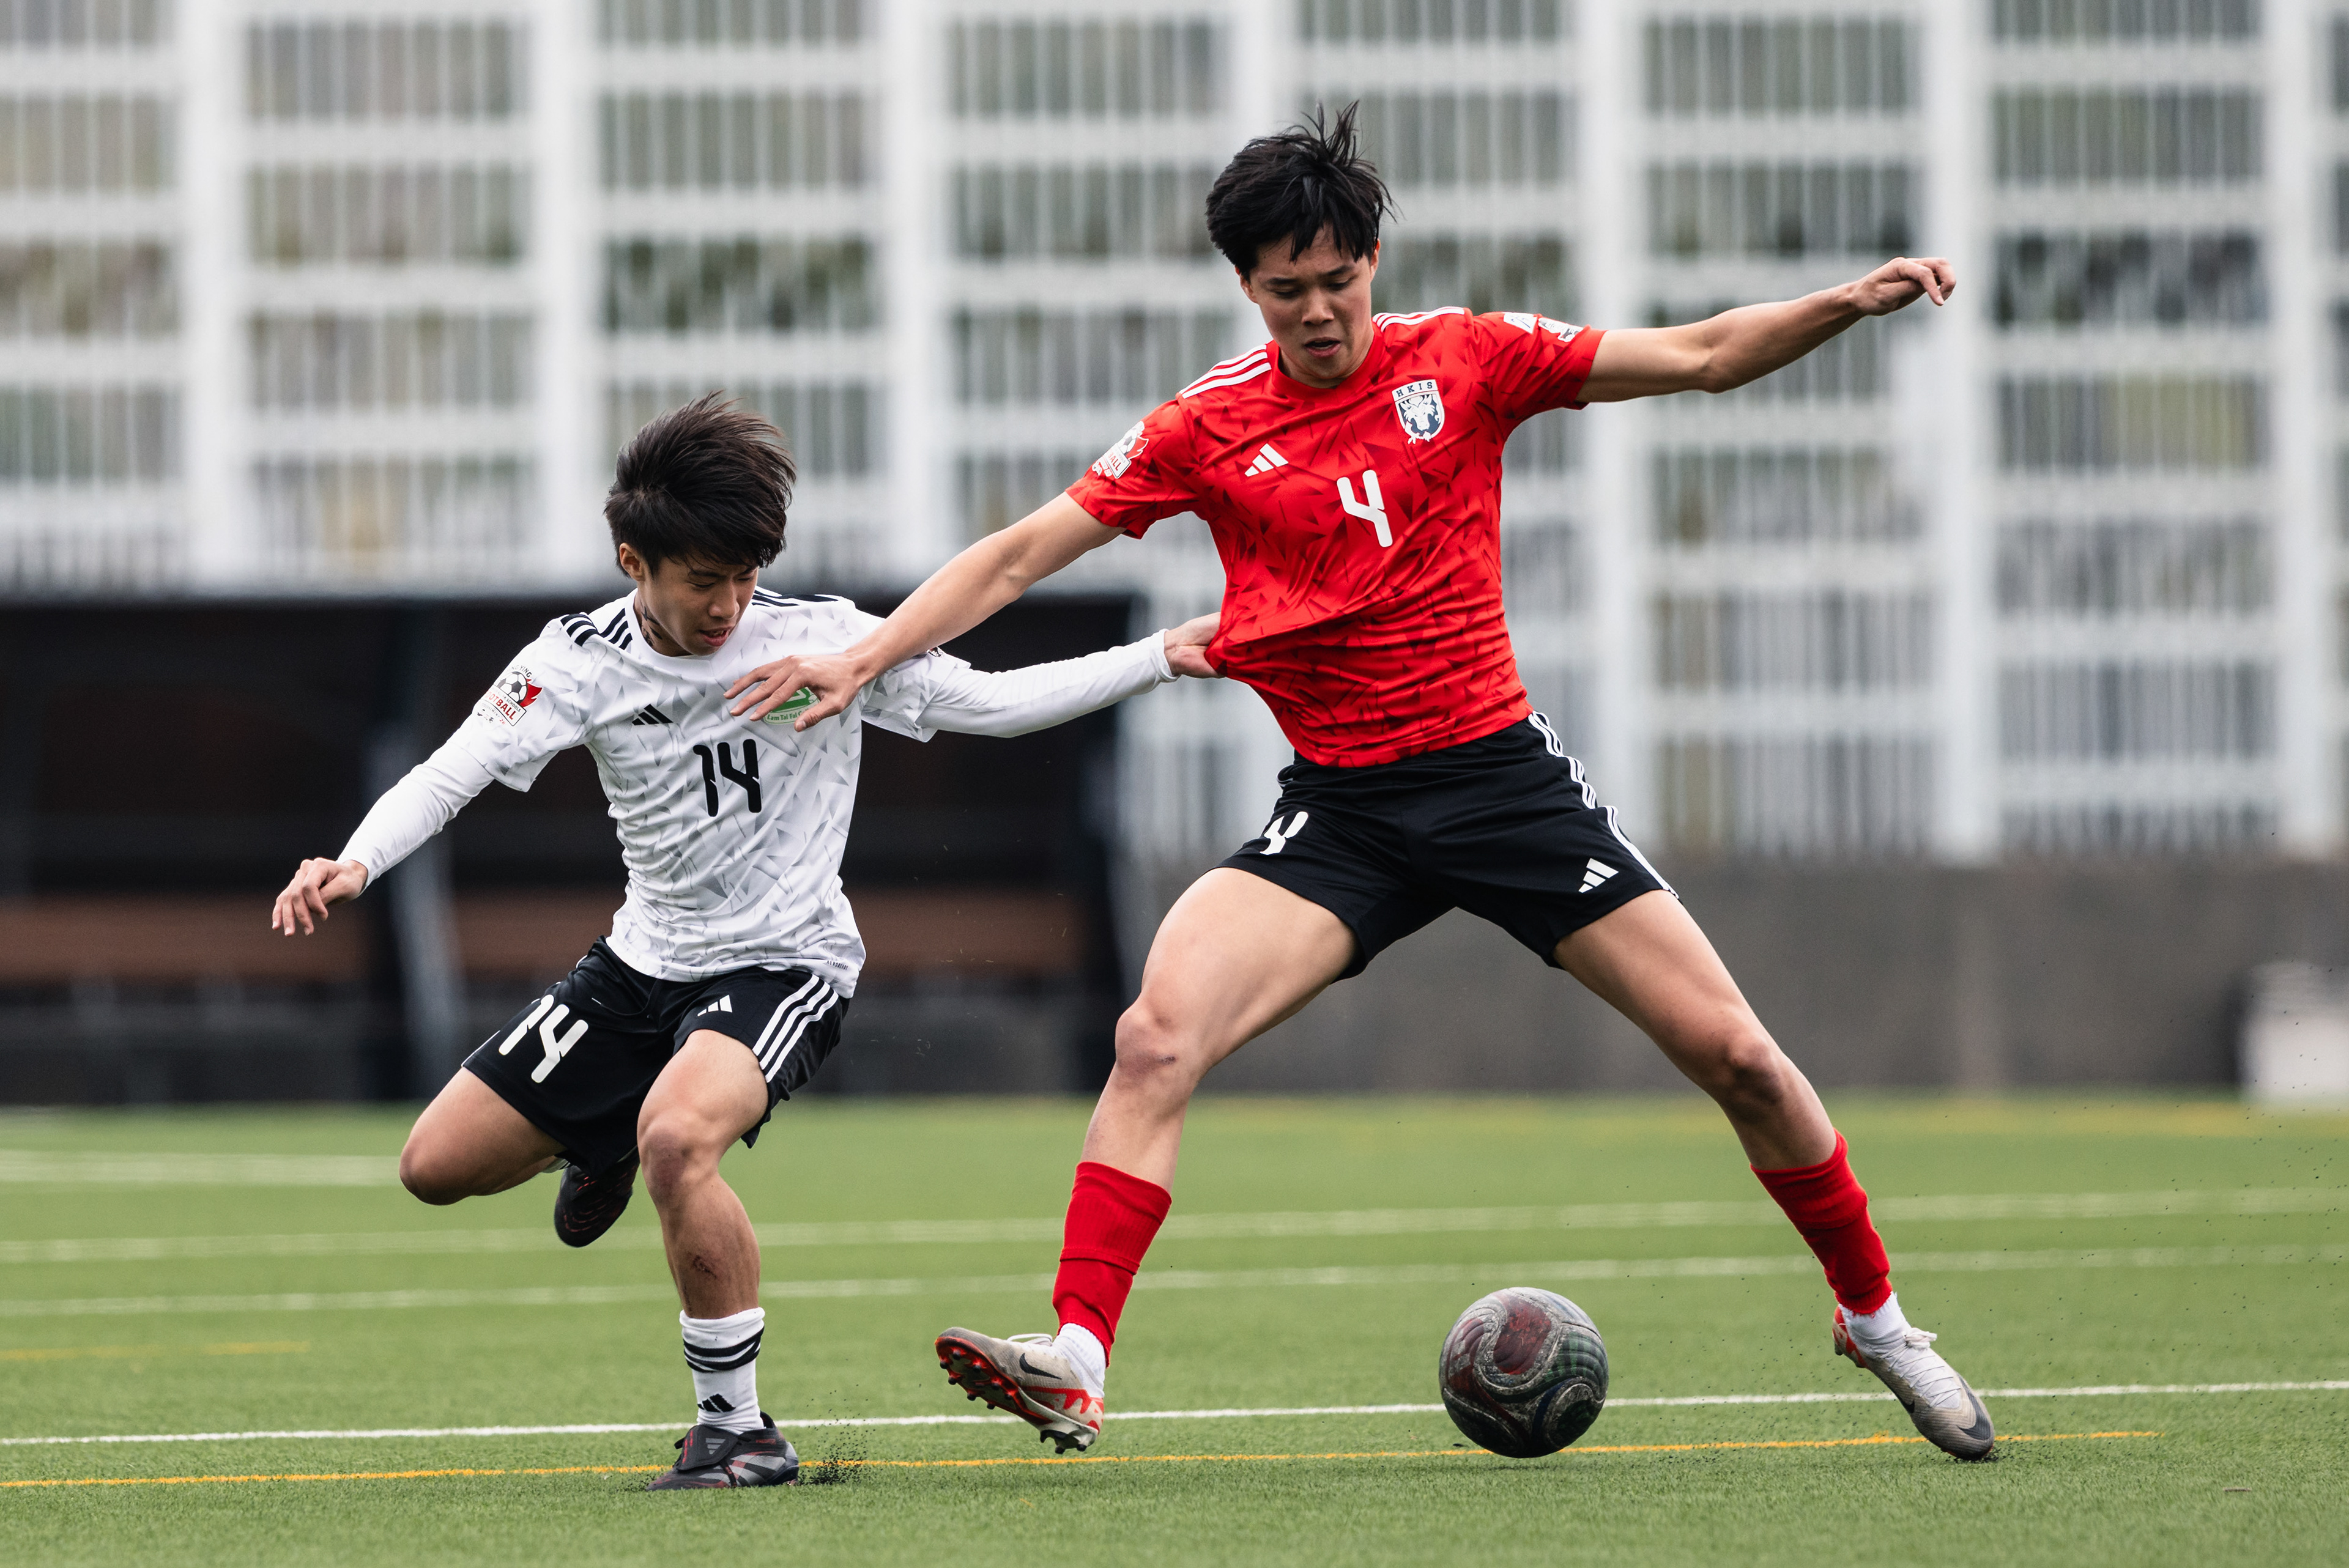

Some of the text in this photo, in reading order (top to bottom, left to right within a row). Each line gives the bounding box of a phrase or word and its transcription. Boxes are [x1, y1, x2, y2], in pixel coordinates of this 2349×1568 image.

[1396, 382, 1433, 397] HKIS
[1337, 469, 1393, 547] 4
[519, 665, 532, 678] YING
[485, 690, 516, 720] OOTBALL
[506, 698, 521, 712] SCHOOLS
[693, 739, 762, 817] 14
[499, 994, 588, 1083] 14
